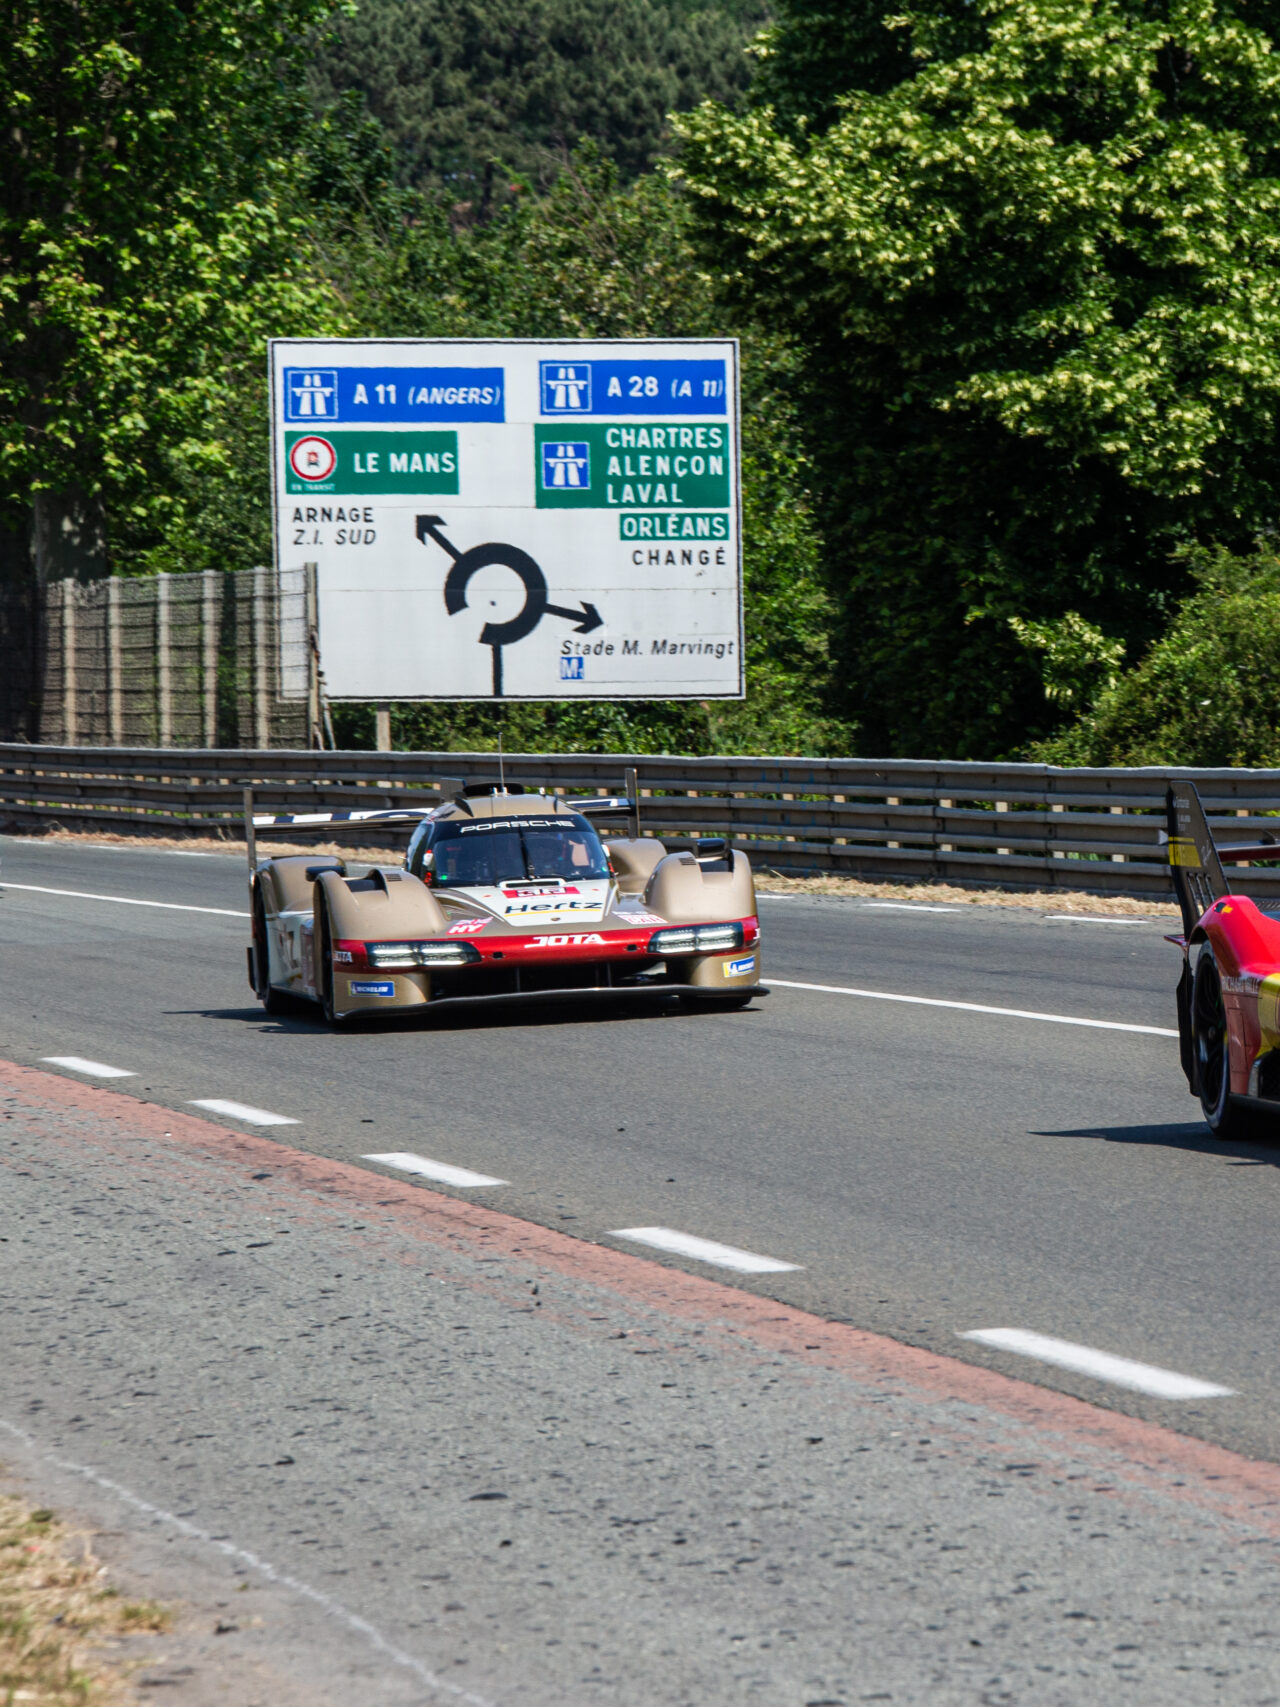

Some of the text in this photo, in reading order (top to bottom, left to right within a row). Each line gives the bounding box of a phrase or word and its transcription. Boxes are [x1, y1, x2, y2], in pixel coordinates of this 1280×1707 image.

[353, 384, 501, 406] A 11 (ANGERS)
[607, 375, 724, 399] A 28 (A 11)
[606, 427, 723, 449] CHARTRES
[354, 453, 456, 473] LE MANS
[607, 455, 724, 478] ALENÇON
[607, 483, 683, 504] LAVAL
[292, 507, 375, 523] ARNAGE
[622, 514, 726, 538] ORLÉANS
[293, 529, 377, 545] Z.I. SUD
[632, 546, 726, 566] CHANGÉ
[561, 639, 735, 659] Stade M. Marvingt
[460, 820, 576, 833] PORSCHE
[504, 901, 603, 914] Hertz
[448, 923, 483, 934] HY
[524, 934, 605, 949] JOTA
